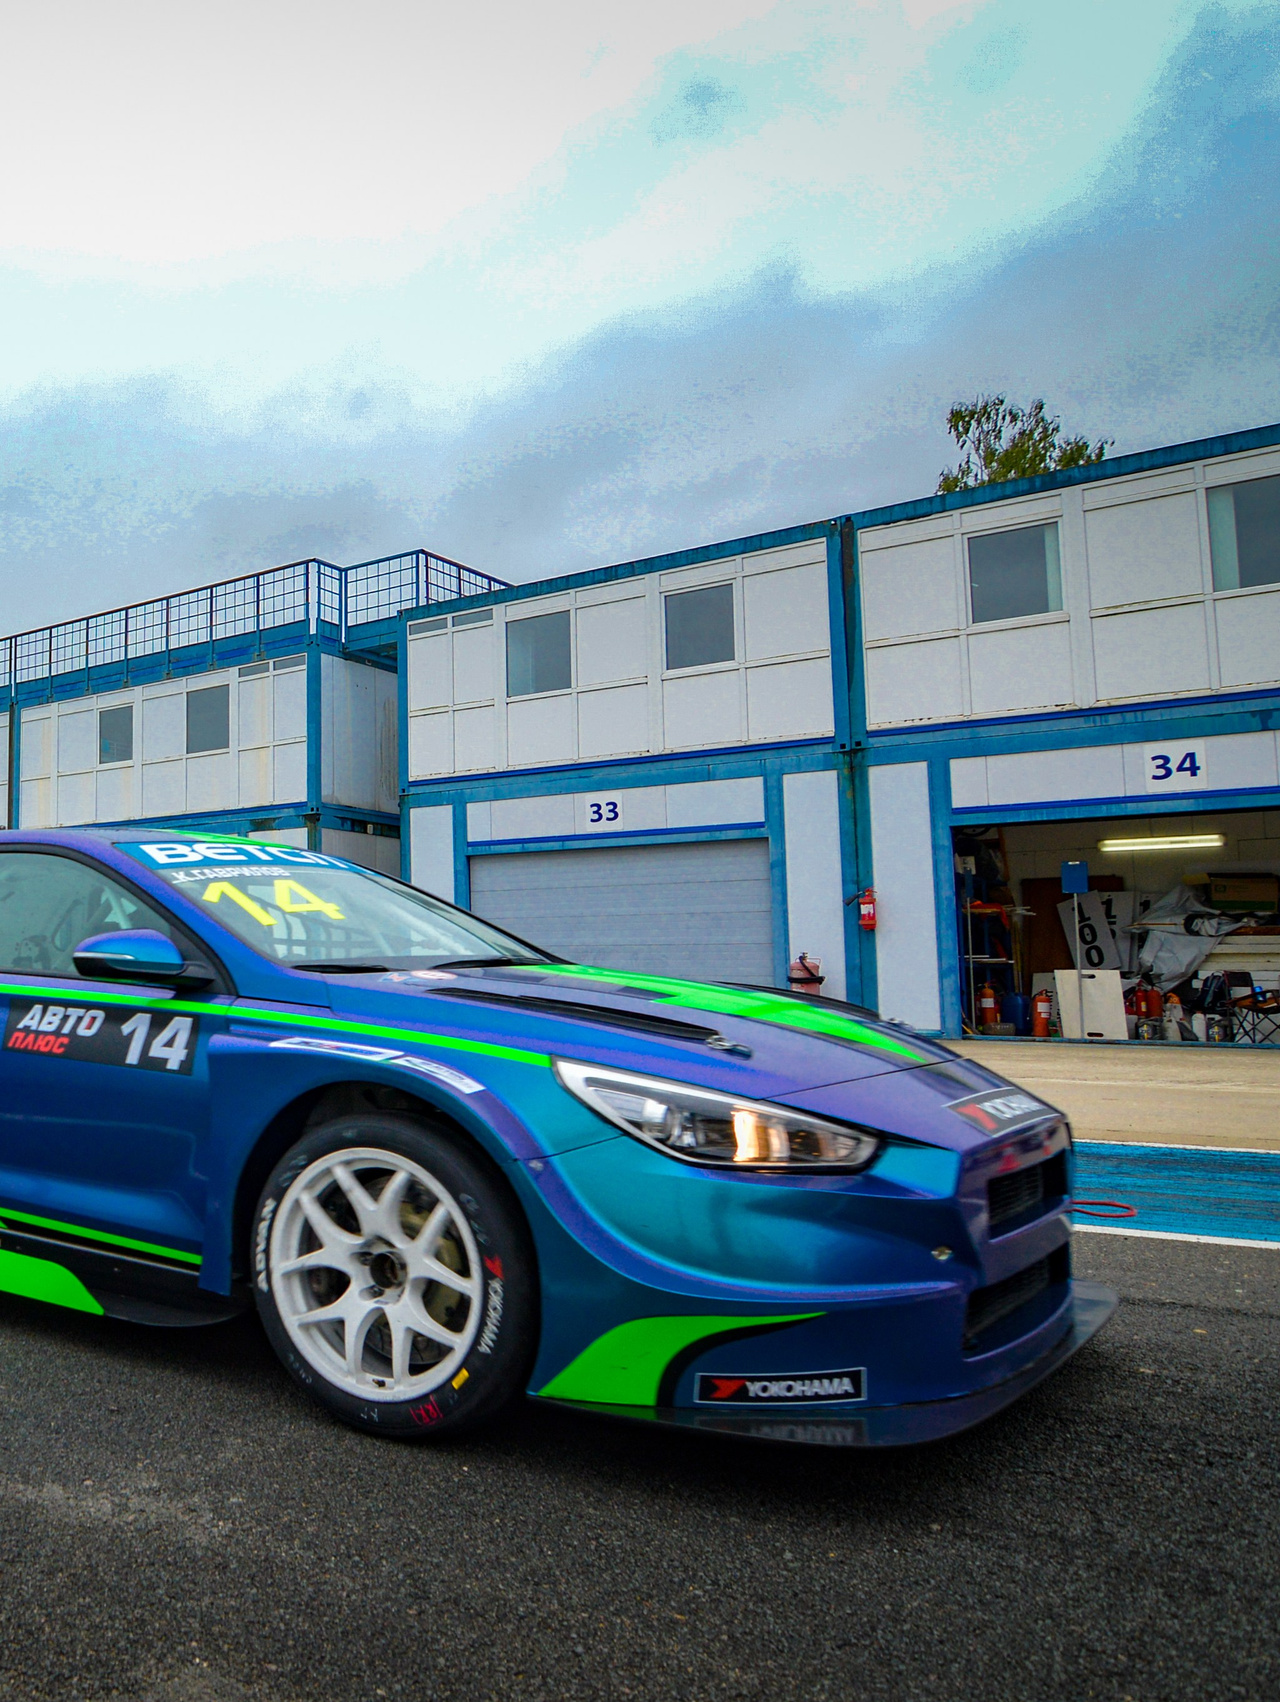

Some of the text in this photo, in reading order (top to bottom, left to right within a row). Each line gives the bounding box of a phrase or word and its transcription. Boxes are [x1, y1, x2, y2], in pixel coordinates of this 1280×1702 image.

[1151, 752, 1201, 781] 34
[590, 801, 619, 823] 33
[172, 866, 291, 883] К.ГАВРИЛОВ
[202, 879, 346, 926] 14
[17, 1004, 106, 1037] АВТО
[7, 1031, 69, 1054] ПЛЮС
[121, 1012, 194, 1070] 14
[478, 1277, 504, 1355] YOKOHAMA
[745, 1377, 855, 1398] YOKOHAMA
